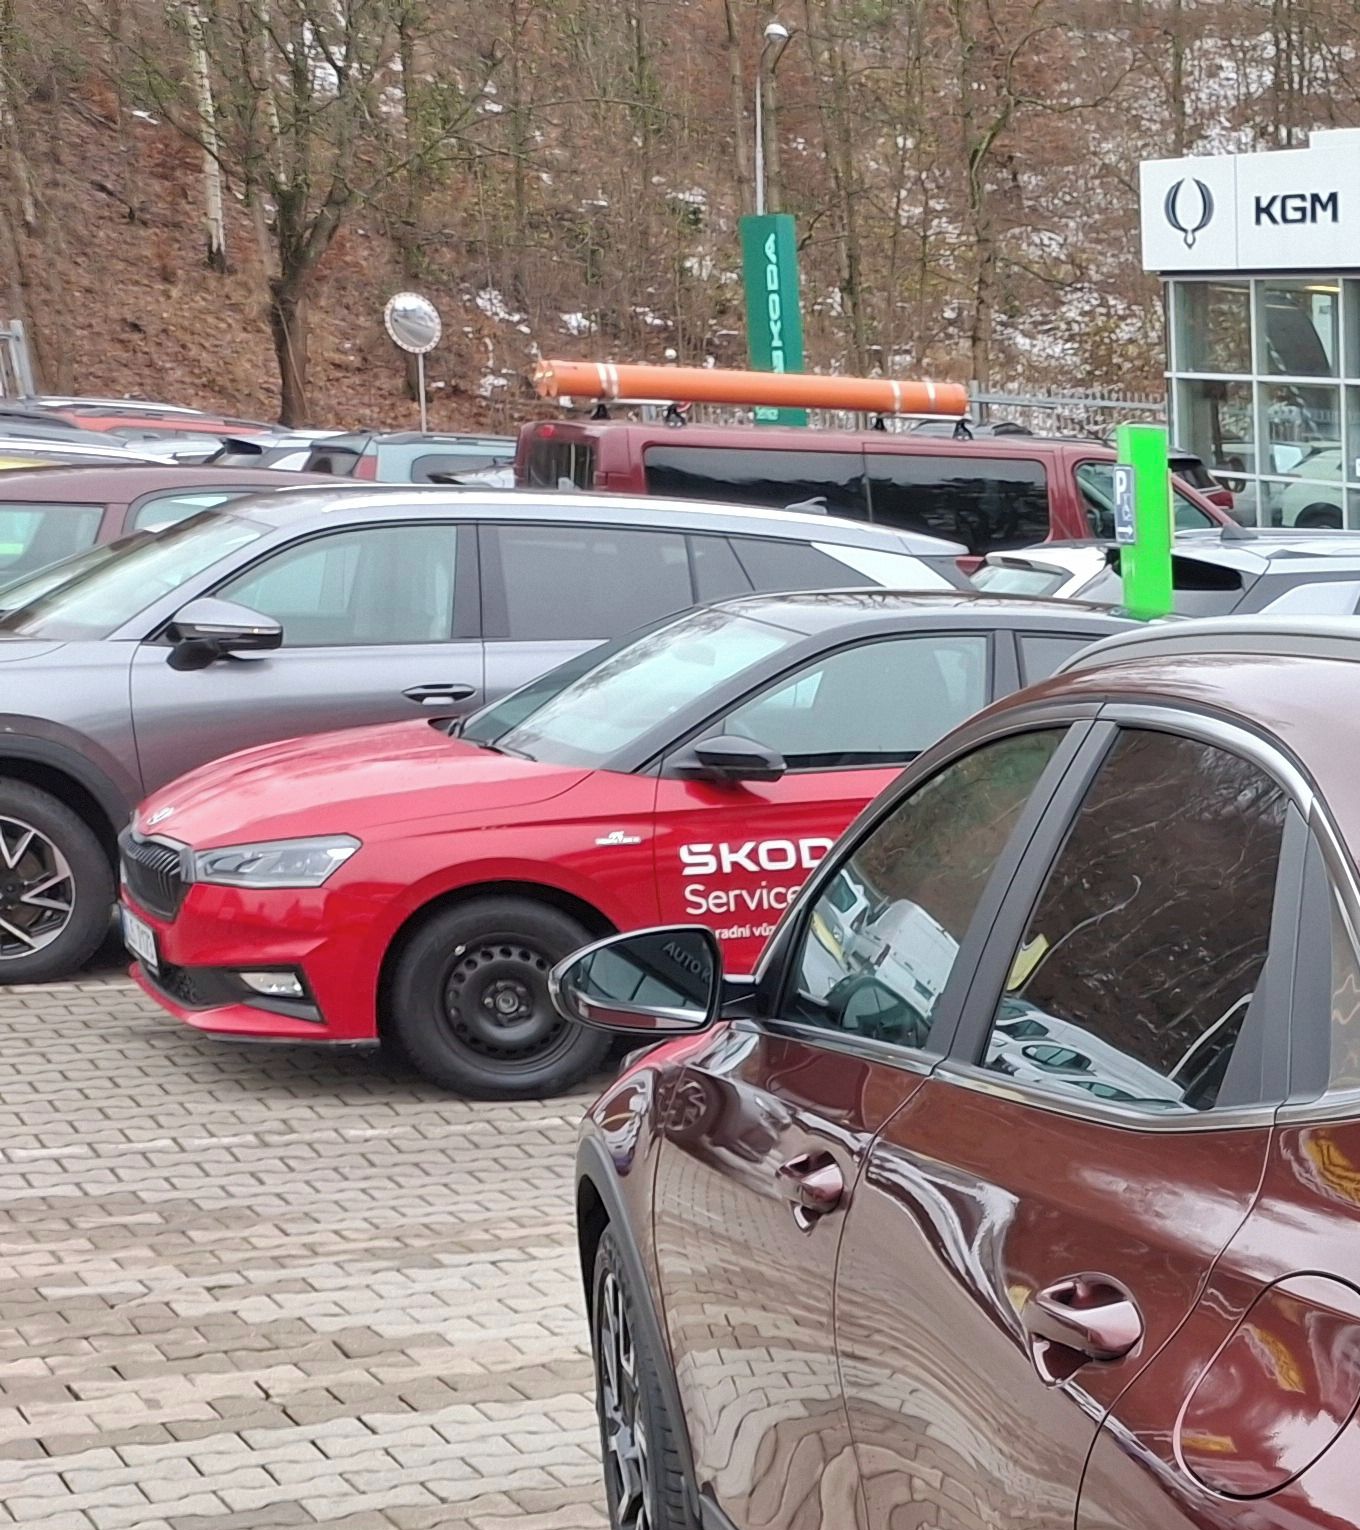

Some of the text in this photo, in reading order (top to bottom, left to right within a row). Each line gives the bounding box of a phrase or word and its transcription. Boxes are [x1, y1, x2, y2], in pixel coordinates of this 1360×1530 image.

[1253, 191, 1340, 226] KGM
[679, 837, 836, 876] SKOD
[715, 923, 751, 940] radní
